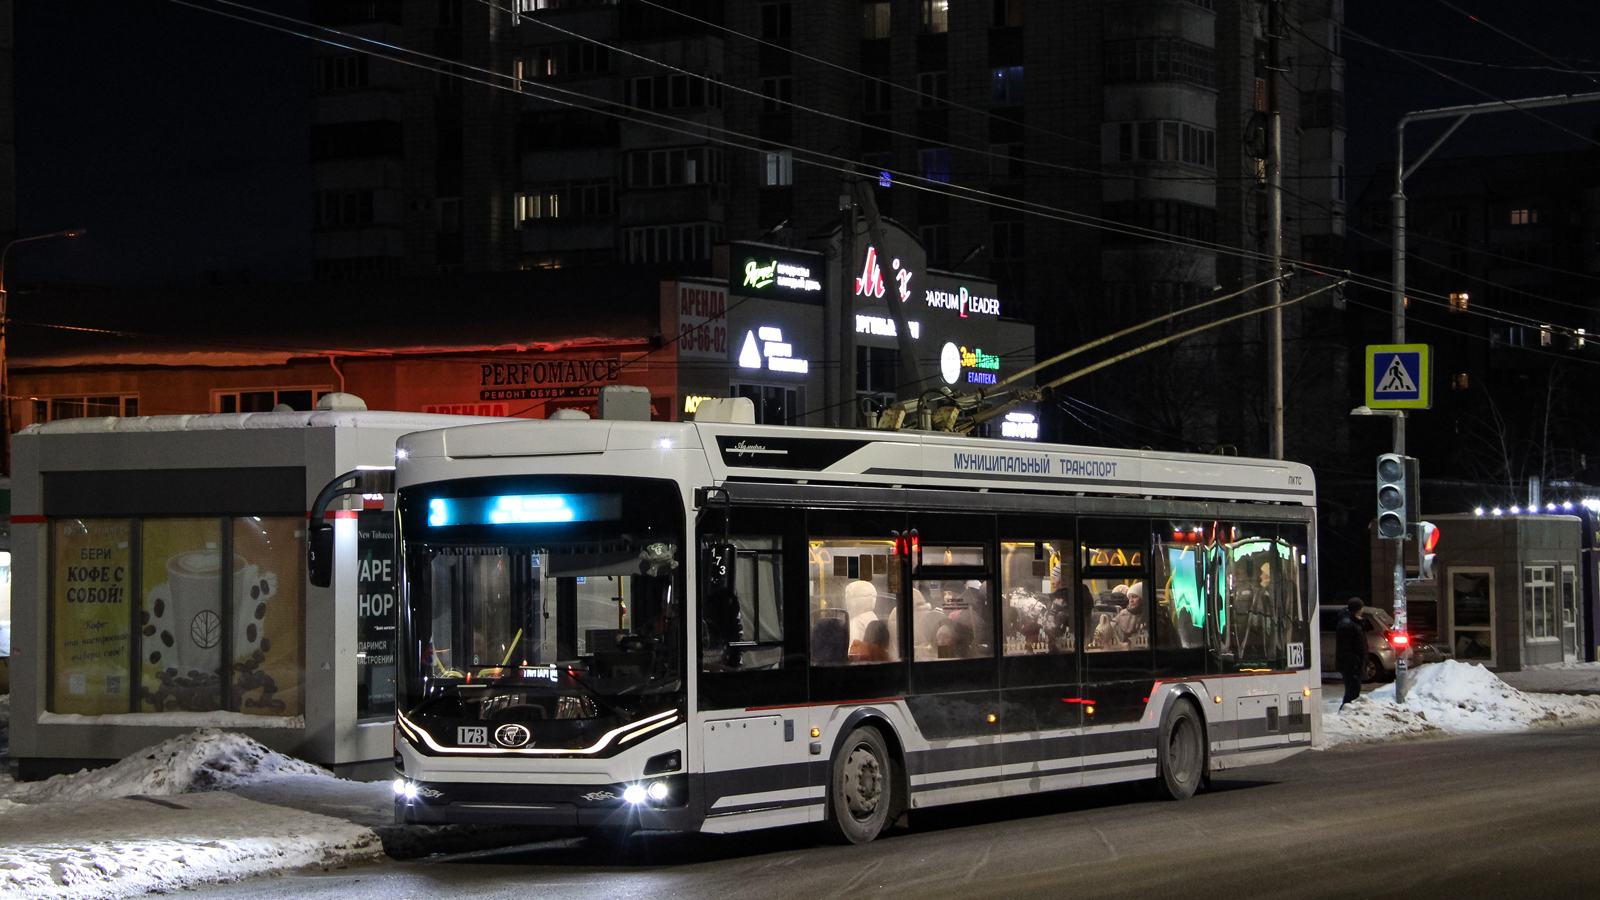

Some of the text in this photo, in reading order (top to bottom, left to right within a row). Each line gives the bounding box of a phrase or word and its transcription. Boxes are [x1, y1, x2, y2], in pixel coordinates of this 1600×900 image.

[681, 287, 725, 322] АРЕНДА
[968, 296, 1000, 315] LEADER
[681, 323, 726, 353] 33-66-02
[481, 358, 620, 386] PERFOMANCE
[484, 390, 526, 399] РЕМОНТ
[530, 388, 565, 398] ОБУВИ
[953, 453, 1117, 477] МУНИЦИПАЛЬНЫЙ ТРАНСПОРТ
[80, 548, 111, 560] БЕРИ
[67, 566, 124, 582] КОФЕ С
[67, 584, 124, 603] СОБОЙ!
[1288, 645, 1303, 665] 173
[460, 728, 484, 743] 173
